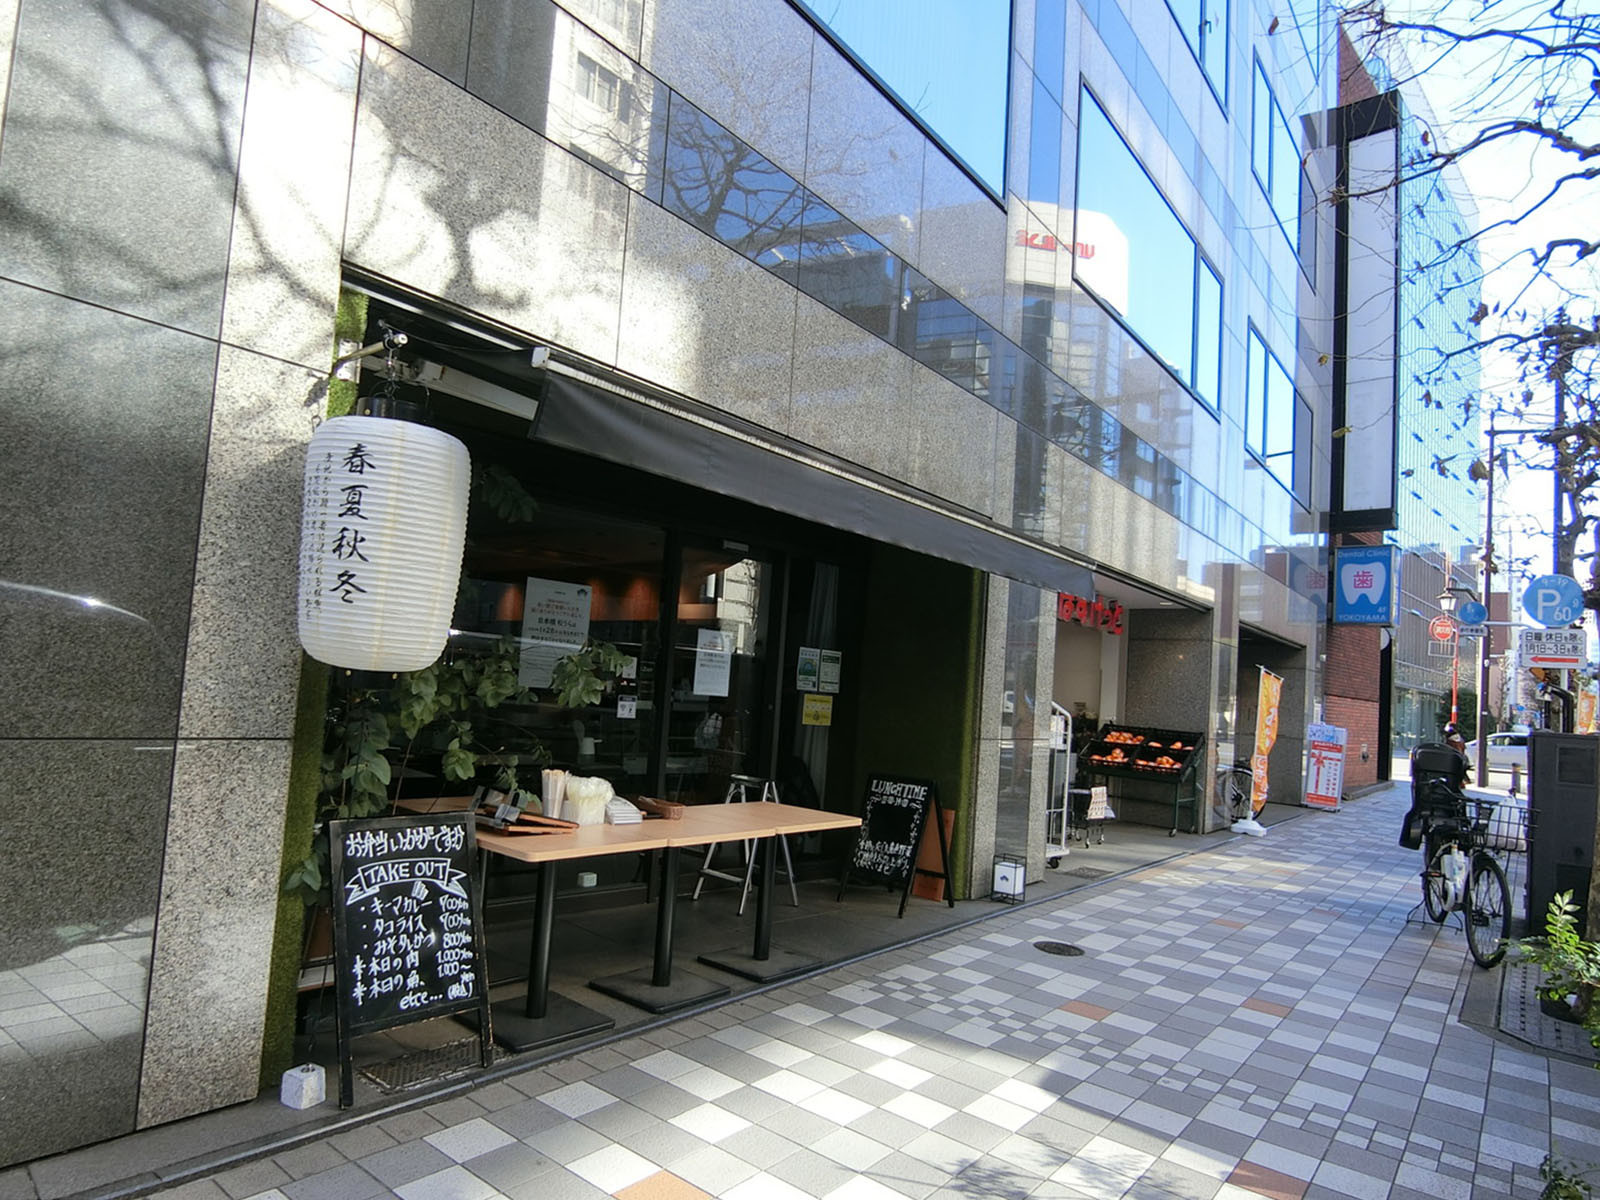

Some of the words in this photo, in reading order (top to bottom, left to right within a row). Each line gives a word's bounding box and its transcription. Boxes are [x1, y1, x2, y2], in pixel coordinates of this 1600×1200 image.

[329, 443, 376, 604] 春夏秋冬
[1338, 550, 1366, 558] Dental
[1367, 550, 1390, 558] Clinic
[1353, 570, 1374, 589] 歯
[1538, 589, 1562, 620] P
[1554, 606, 1572, 621] 60
[346, 824, 465, 858] お弁当いかがですか
[364, 862, 410, 884] TAKE
[415, 861, 448, 880] OUT
